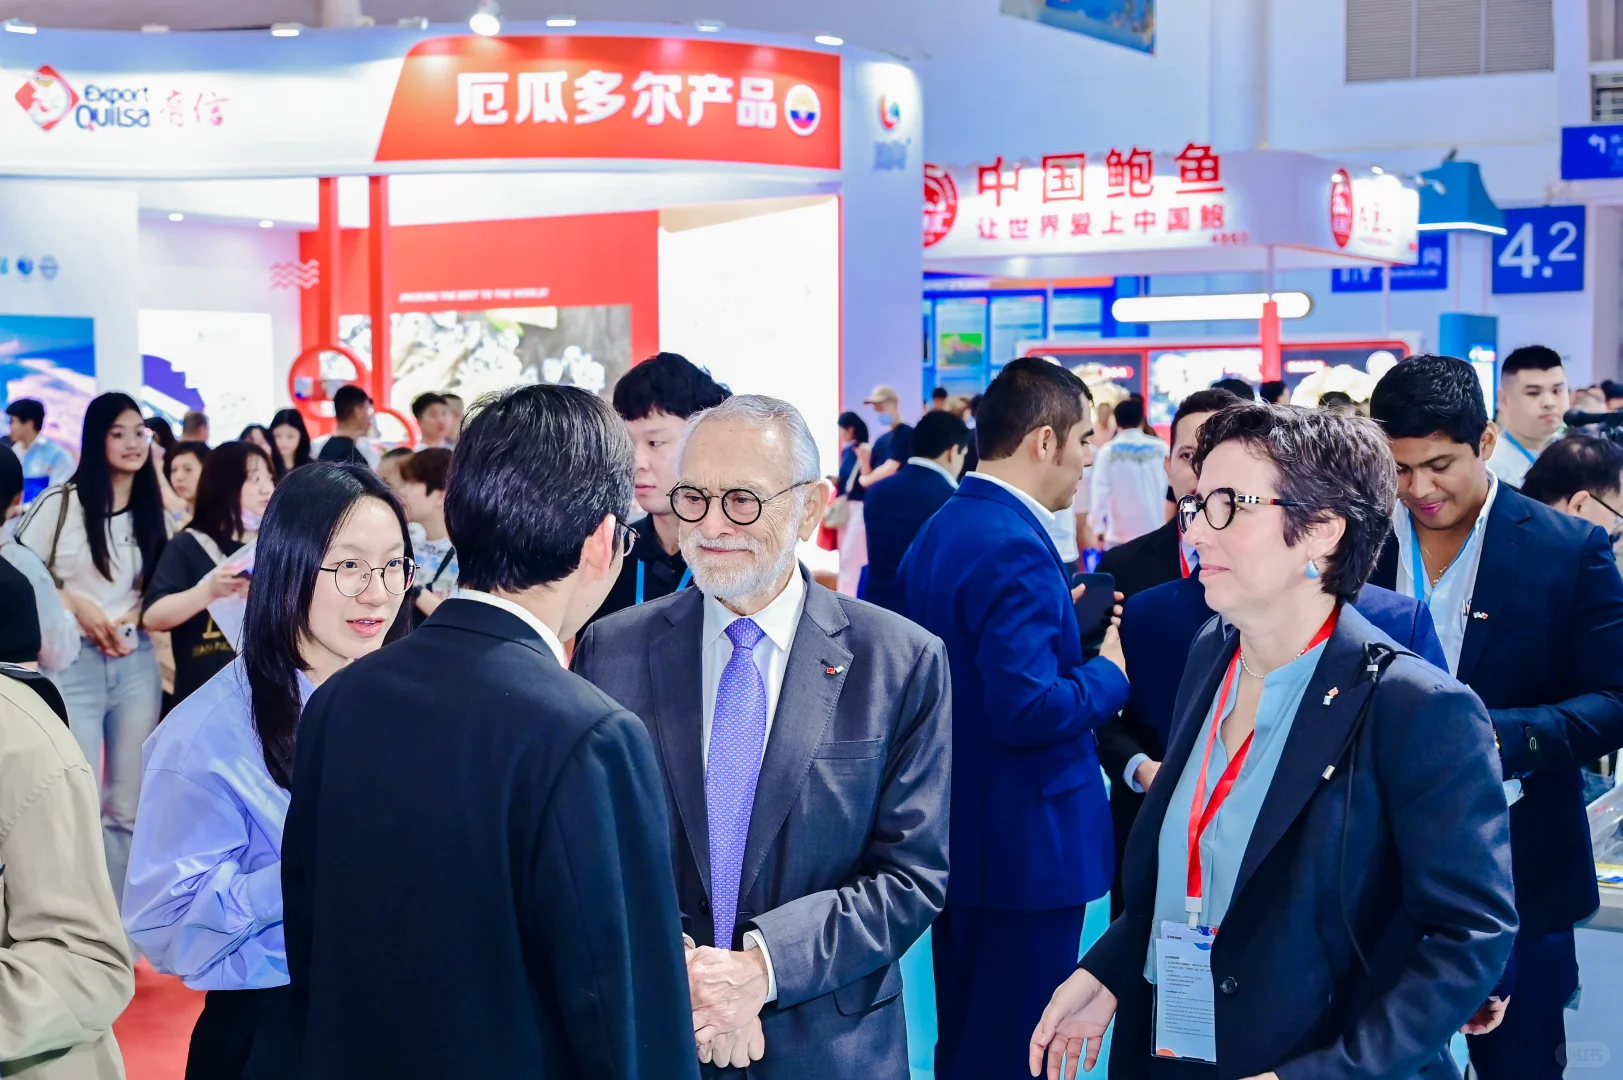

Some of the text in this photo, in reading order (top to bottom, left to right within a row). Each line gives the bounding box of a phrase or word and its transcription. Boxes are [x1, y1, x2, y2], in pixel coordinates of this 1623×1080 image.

[83, 84, 149, 105] Export
[454, 70, 777, 129] 厄瓜多尔产品
[977, 142, 1225, 207] 中国鲍鱼
[977, 204, 1225, 241] 让世界爱上中国鲍
[1498, 221, 1578, 279] 4.2
